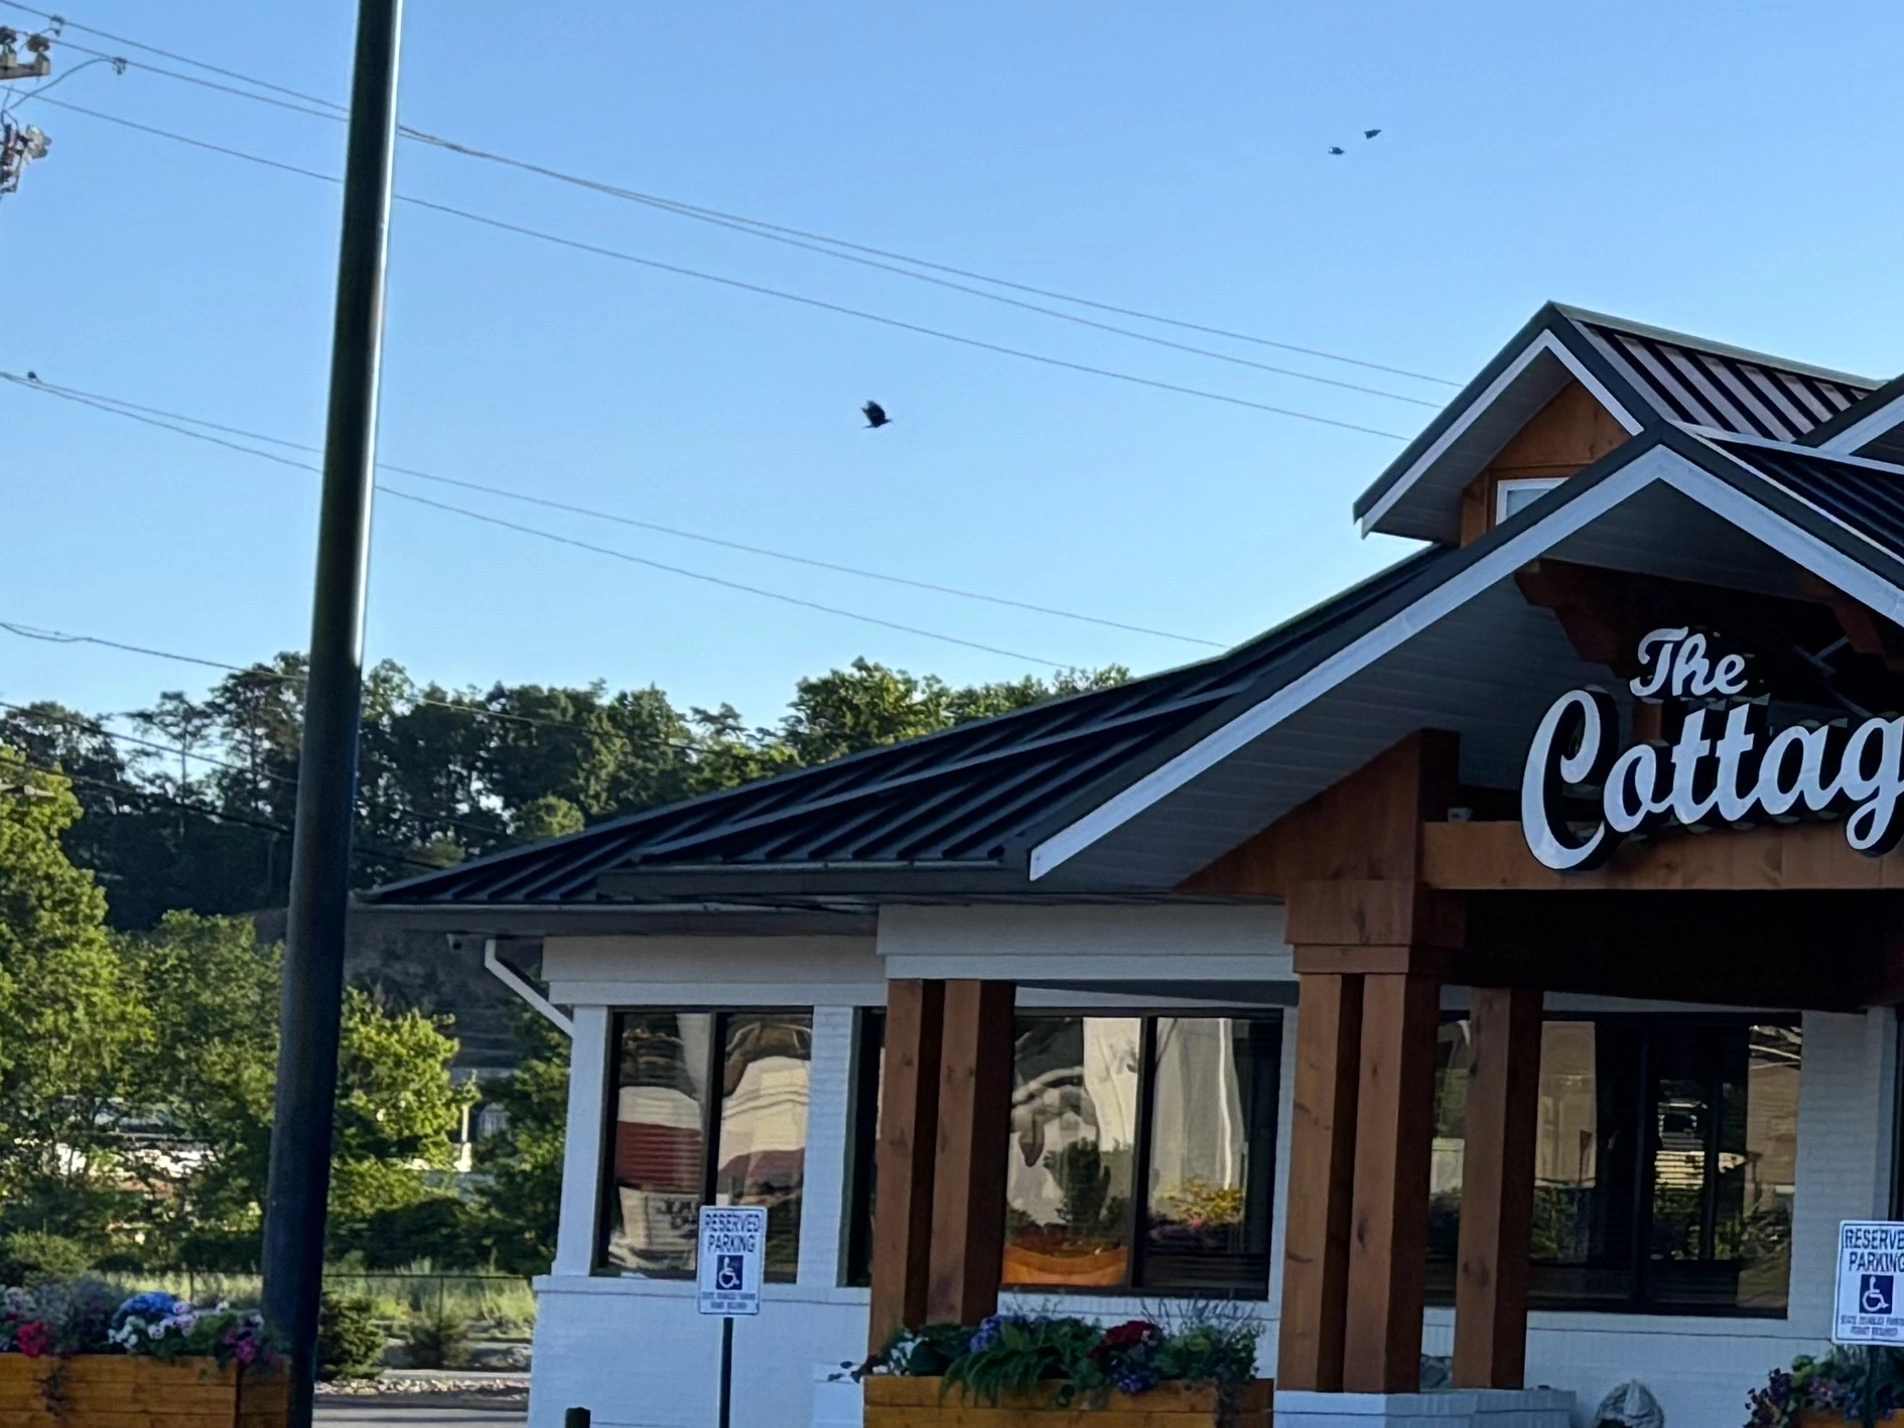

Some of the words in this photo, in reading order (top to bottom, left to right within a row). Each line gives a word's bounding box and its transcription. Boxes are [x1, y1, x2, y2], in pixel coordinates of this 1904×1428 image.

[1629, 626, 1748, 697] The
[705, 1213, 760, 1233] RESERVED
[707, 1233, 756, 1253] PARKING
